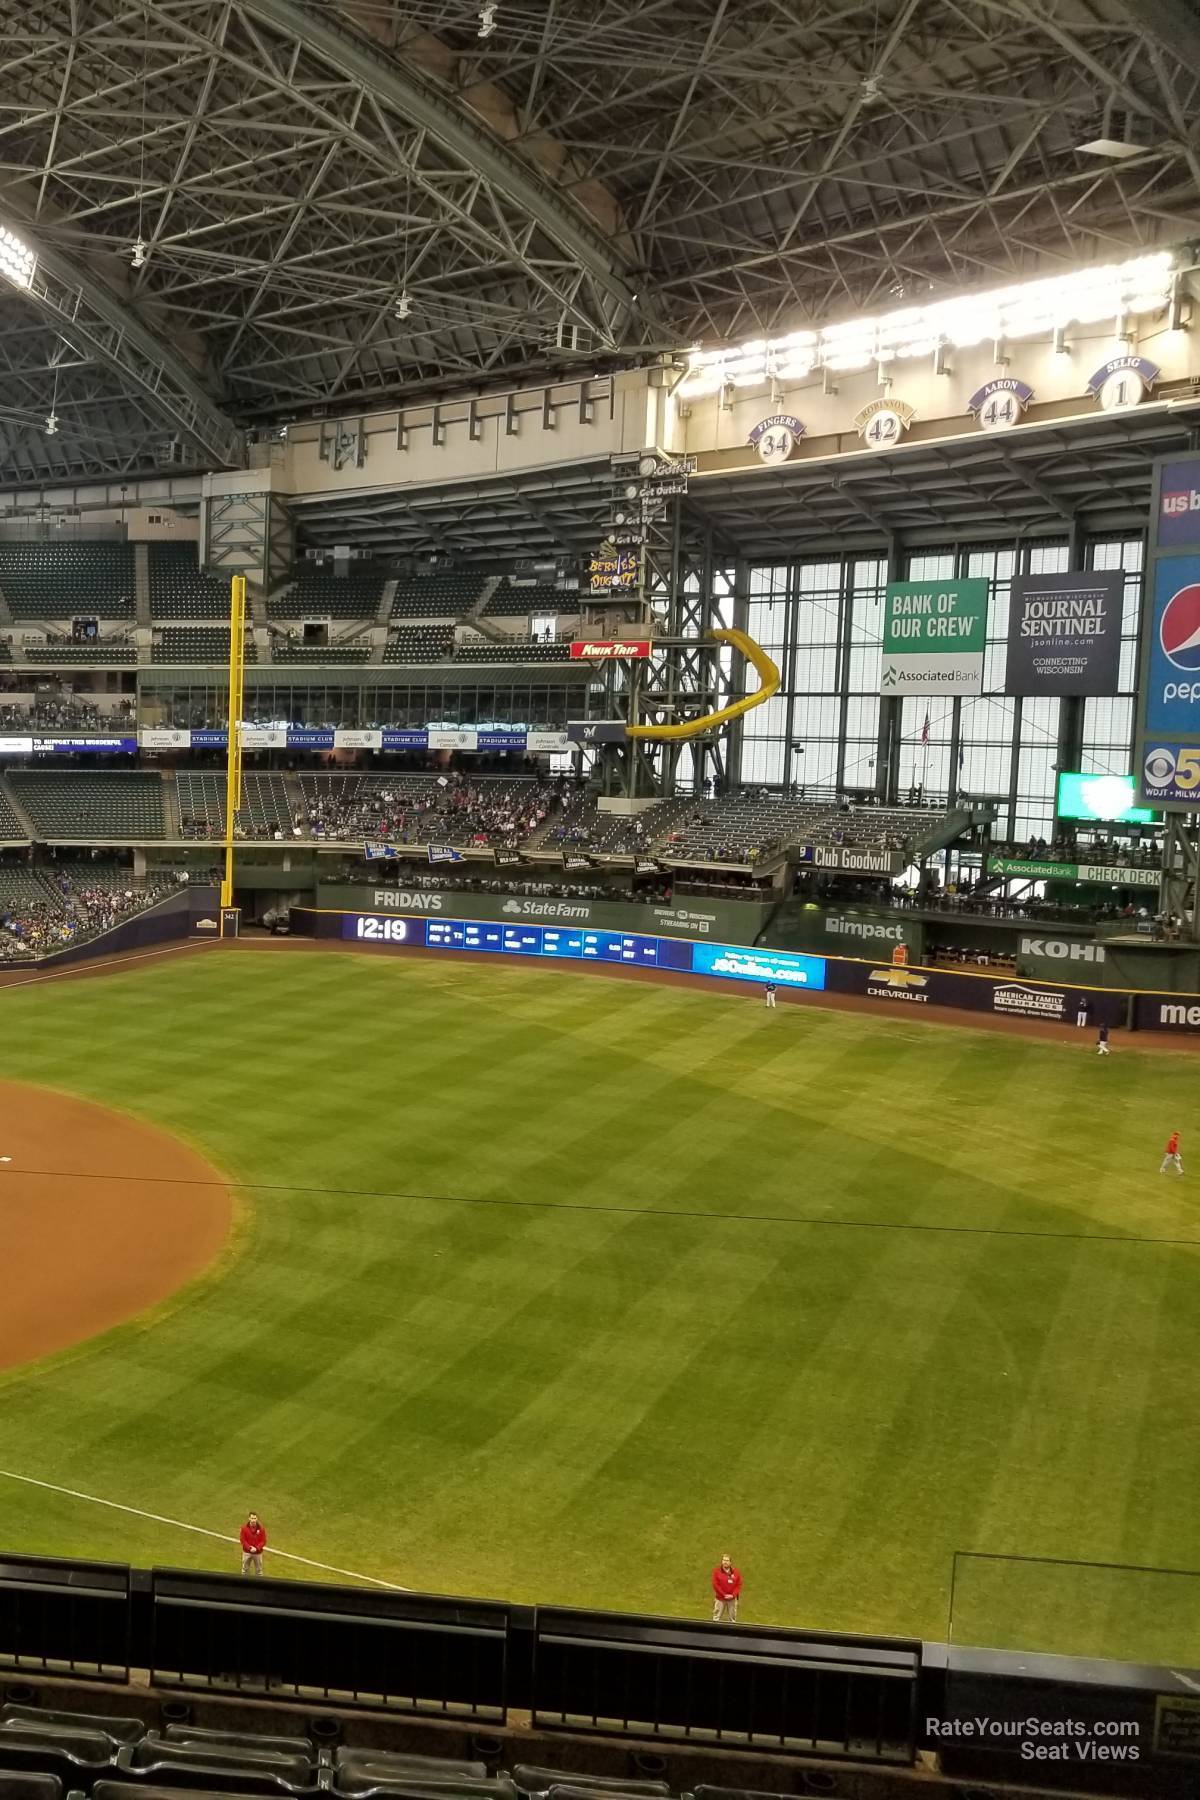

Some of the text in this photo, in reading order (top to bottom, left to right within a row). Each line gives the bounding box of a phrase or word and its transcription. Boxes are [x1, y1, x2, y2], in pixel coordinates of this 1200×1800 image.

[1106, 357, 1141, 373] SELIG
[984, 380, 1018, 396] AARON
[1115, 380, 1128, 406] 1
[862, 399, 906, 419] ROBINSON
[984, 397, 1013, 425] 44
[758, 416, 798, 432] FINGERS
[869, 417, 897, 442] 42
[763, 433, 788, 456] 34
[892, 593, 957, 615] BANK OF
[1022, 599, 1107, 621] JOURNAL
[891, 618, 921, 638] OUR
[1020, 617, 1106, 637] SENTINEL
[1031, 638, 1094, 648] jsonline.com
[1033, 656, 1088, 666] CONNECTING
[1036, 665, 1084, 674] WISCONSIN
[1145, 788, 1168, 797] WDJT
[814, 847, 891, 871] Club Goodwill
[1087, 867, 1161, 885] CHECK DECK
[374, 891, 442, 910] FRIDAYS
[357, 917, 407, 940] 12:19
[839, 916, 904, 939] impact
[867, 987, 929, 1002] CHEVROLET
[994, 990, 1063, 1005] AMERICAN FAMILY
